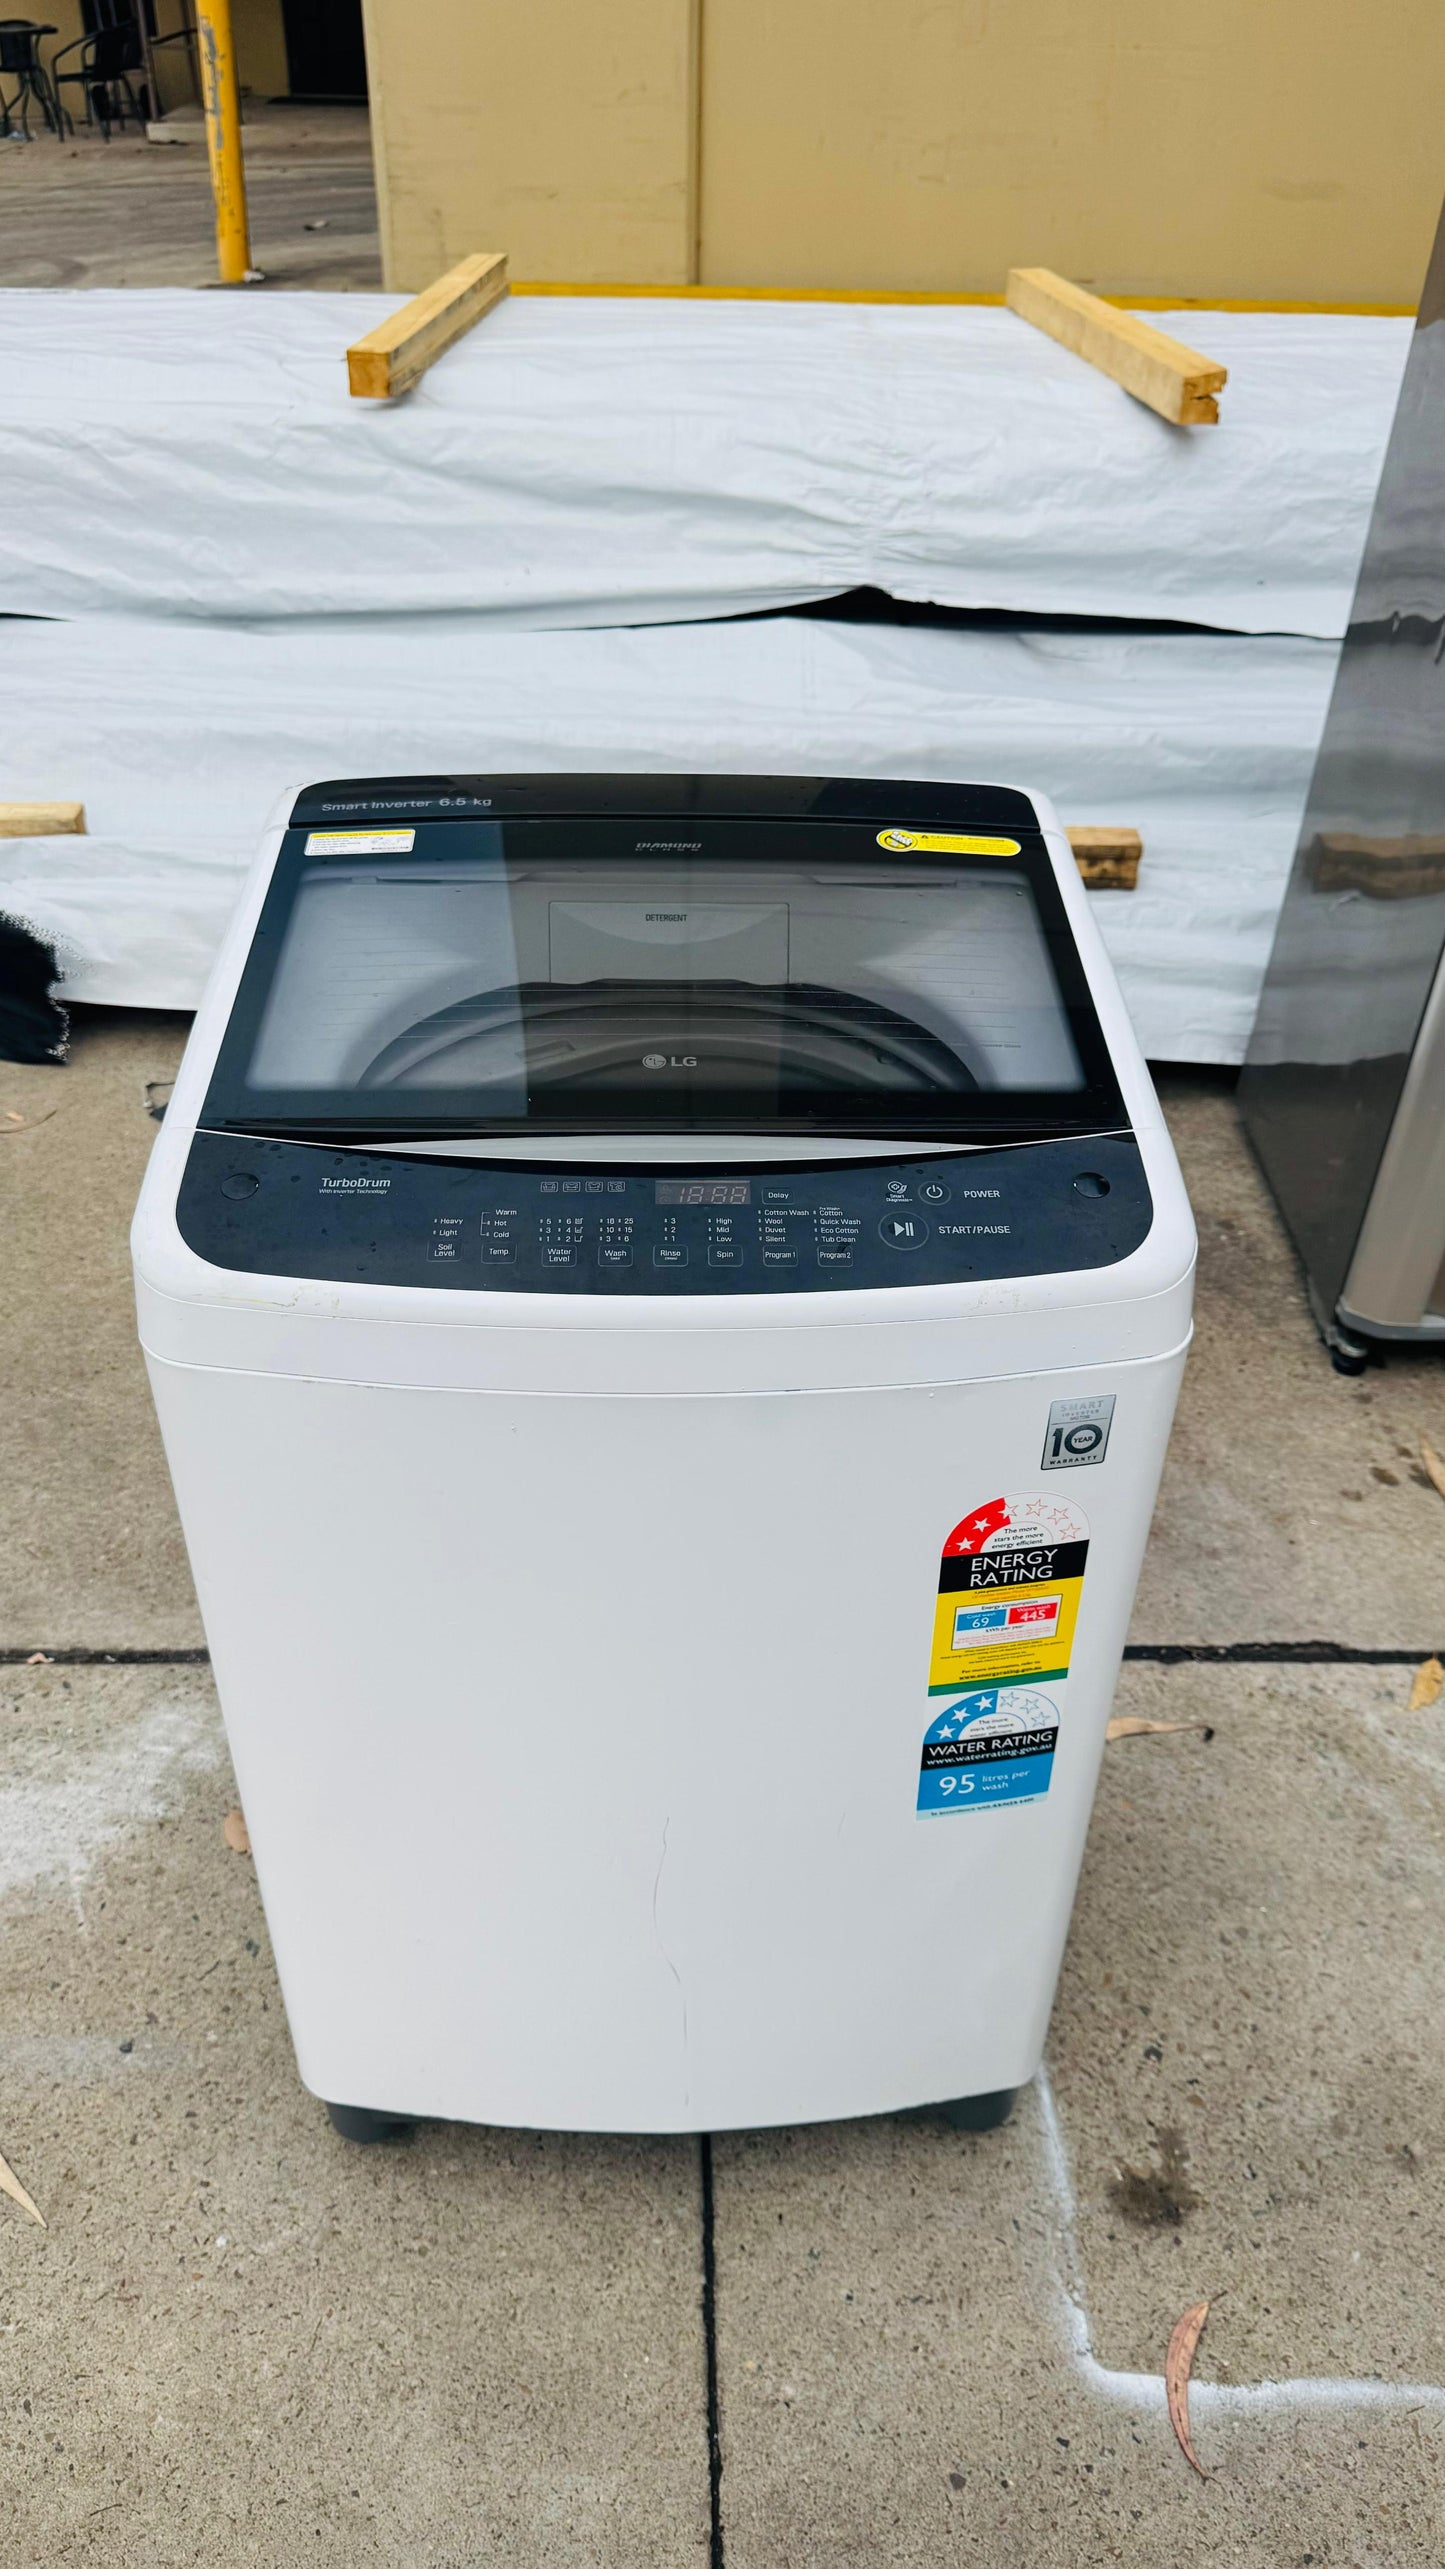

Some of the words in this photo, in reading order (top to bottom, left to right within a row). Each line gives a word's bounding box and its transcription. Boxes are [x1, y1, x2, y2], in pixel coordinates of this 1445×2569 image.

[322, 802, 368, 811] Smart
[371, 800, 432, 809] Inverter
[439, 797, 467, 807] 6.5
[473, 798, 492, 807] kg
[645, 913, 688, 921] DETERGENT
[671, 1056, 697, 1067] LG
[321, 1177, 391, 1188] TurboDrum
[768, 1191, 789, 1200] Delay
[963, 1190, 1001, 1198] POWER
[938, 1225, 1011, 1234] START/PAUSE
[437, 1243, 453, 1251] Soil
[716, 1251, 734, 1259] Spin
[765, 1252, 791, 1260] Program
[820, 1251, 846, 1260] Program
[1060, 1400, 1104, 1412] SMART
[1052, 1424, 1103, 1457] 10
[1050, 1455, 1098, 1465] WARRANTY
[971, 1549, 1058, 1572] ENERGY
[970, 1566, 1053, 1588] RATING
[1020, 1609, 1046, 1622] 445
[972, 1617, 989, 1628] 69
[929, 1741, 986, 1757] WATER
[991, 1731, 1053, 1750] RATING
[926, 1743, 1053, 1766] www.waterrating.gov.au
[939, 1773, 976, 1796] 95
[982, 1774, 1009, 1783] litres
[1012, 1770, 1031, 1780] per
[982, 1781, 1009, 1791] wash
